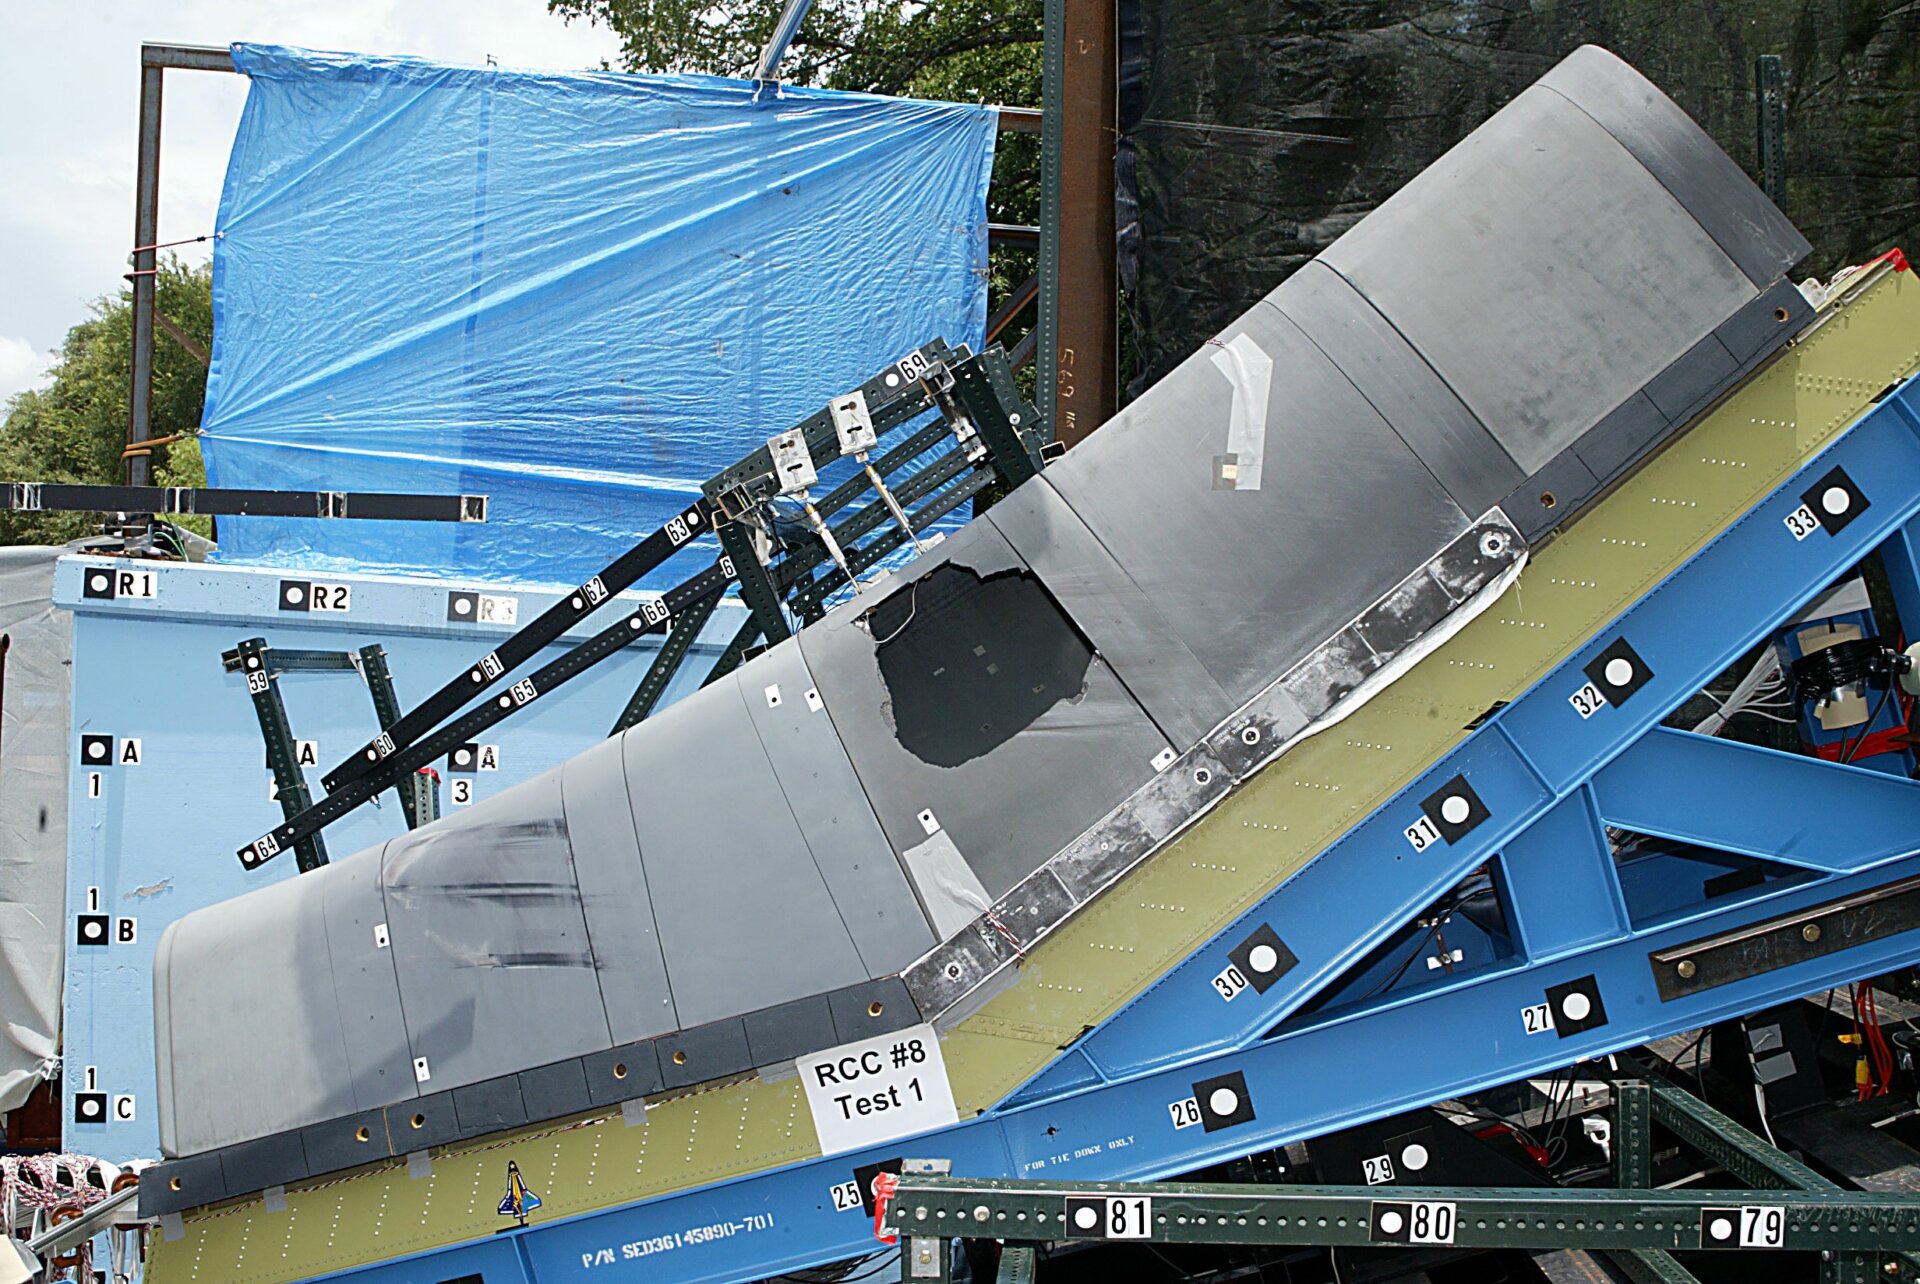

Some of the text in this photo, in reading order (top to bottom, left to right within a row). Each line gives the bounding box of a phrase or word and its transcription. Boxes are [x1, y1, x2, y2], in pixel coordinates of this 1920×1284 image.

[901, 353, 927, 380] 69
[666, 519, 688, 542] 63
[1787, 508, 1817, 537] 33
[120, 573, 151, 596] R1
[585, 577, 606, 600] 62
[314, 587, 347, 609] R2
[645, 600, 667, 621] 66
[484, 655, 502, 677] 61
[249, 672, 268, 690] 59
[513, 682, 535, 701] 65
[1572, 686, 1603, 715] 32
[122, 741, 138, 763] A
[300, 743, 315, 765] A
[375, 734, 394, 756] 60
[481, 747, 496, 769] A
[91, 773, 98, 796] 1
[455, 781, 469, 802] 3
[1408, 819, 1437, 849] 31
[257, 836, 277, 857] 64
[89, 888, 97, 910] 1
[119, 920, 134, 941] B
[1216, 968, 1246, 998] 30
[1525, 1005, 1548, 1032] 27
[814, 1040, 926, 1087] RCC #8
[87, 1068, 95, 1089] 1
[117, 1097, 131, 1118] C
[834, 1077, 923, 1120] Test 1
[1172, 1100, 1199, 1127] 26
[1024, 1160, 1045, 1172] FOR
[1050, 1153, 1070, 1165] TIE
[1366, 1157, 1393, 1184] 29
[833, 1183, 860, 1208] 25
[1112, 1199, 1145, 1235] 81
[1414, 1204, 1451, 1241] 80
[1745, 1208, 1782, 1245] 79
[582, 1248, 616, 1268] P/N
